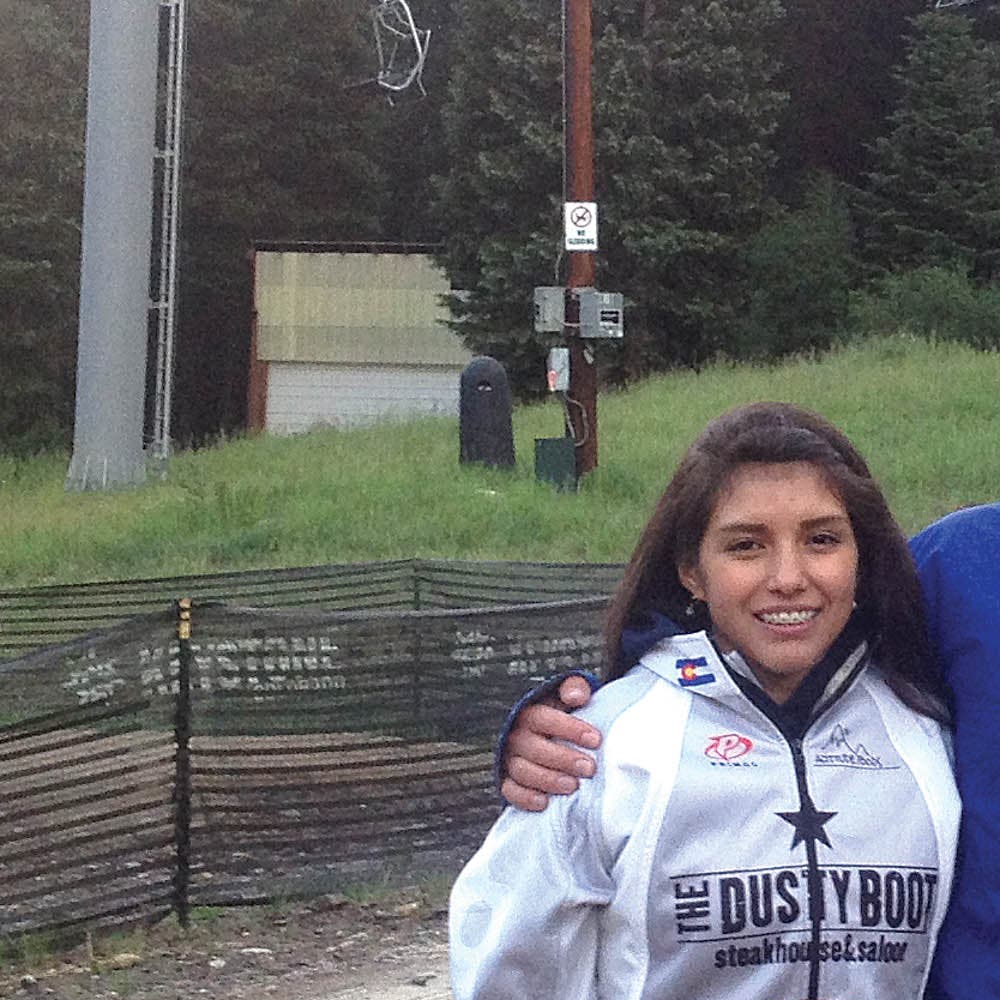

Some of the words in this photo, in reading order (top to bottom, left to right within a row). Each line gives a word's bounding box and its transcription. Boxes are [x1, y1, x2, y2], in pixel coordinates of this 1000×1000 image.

[675, 880, 711, 935] THE
[719, 869, 851, 935] DUSTY
[859, 869, 938, 930] BOOT
